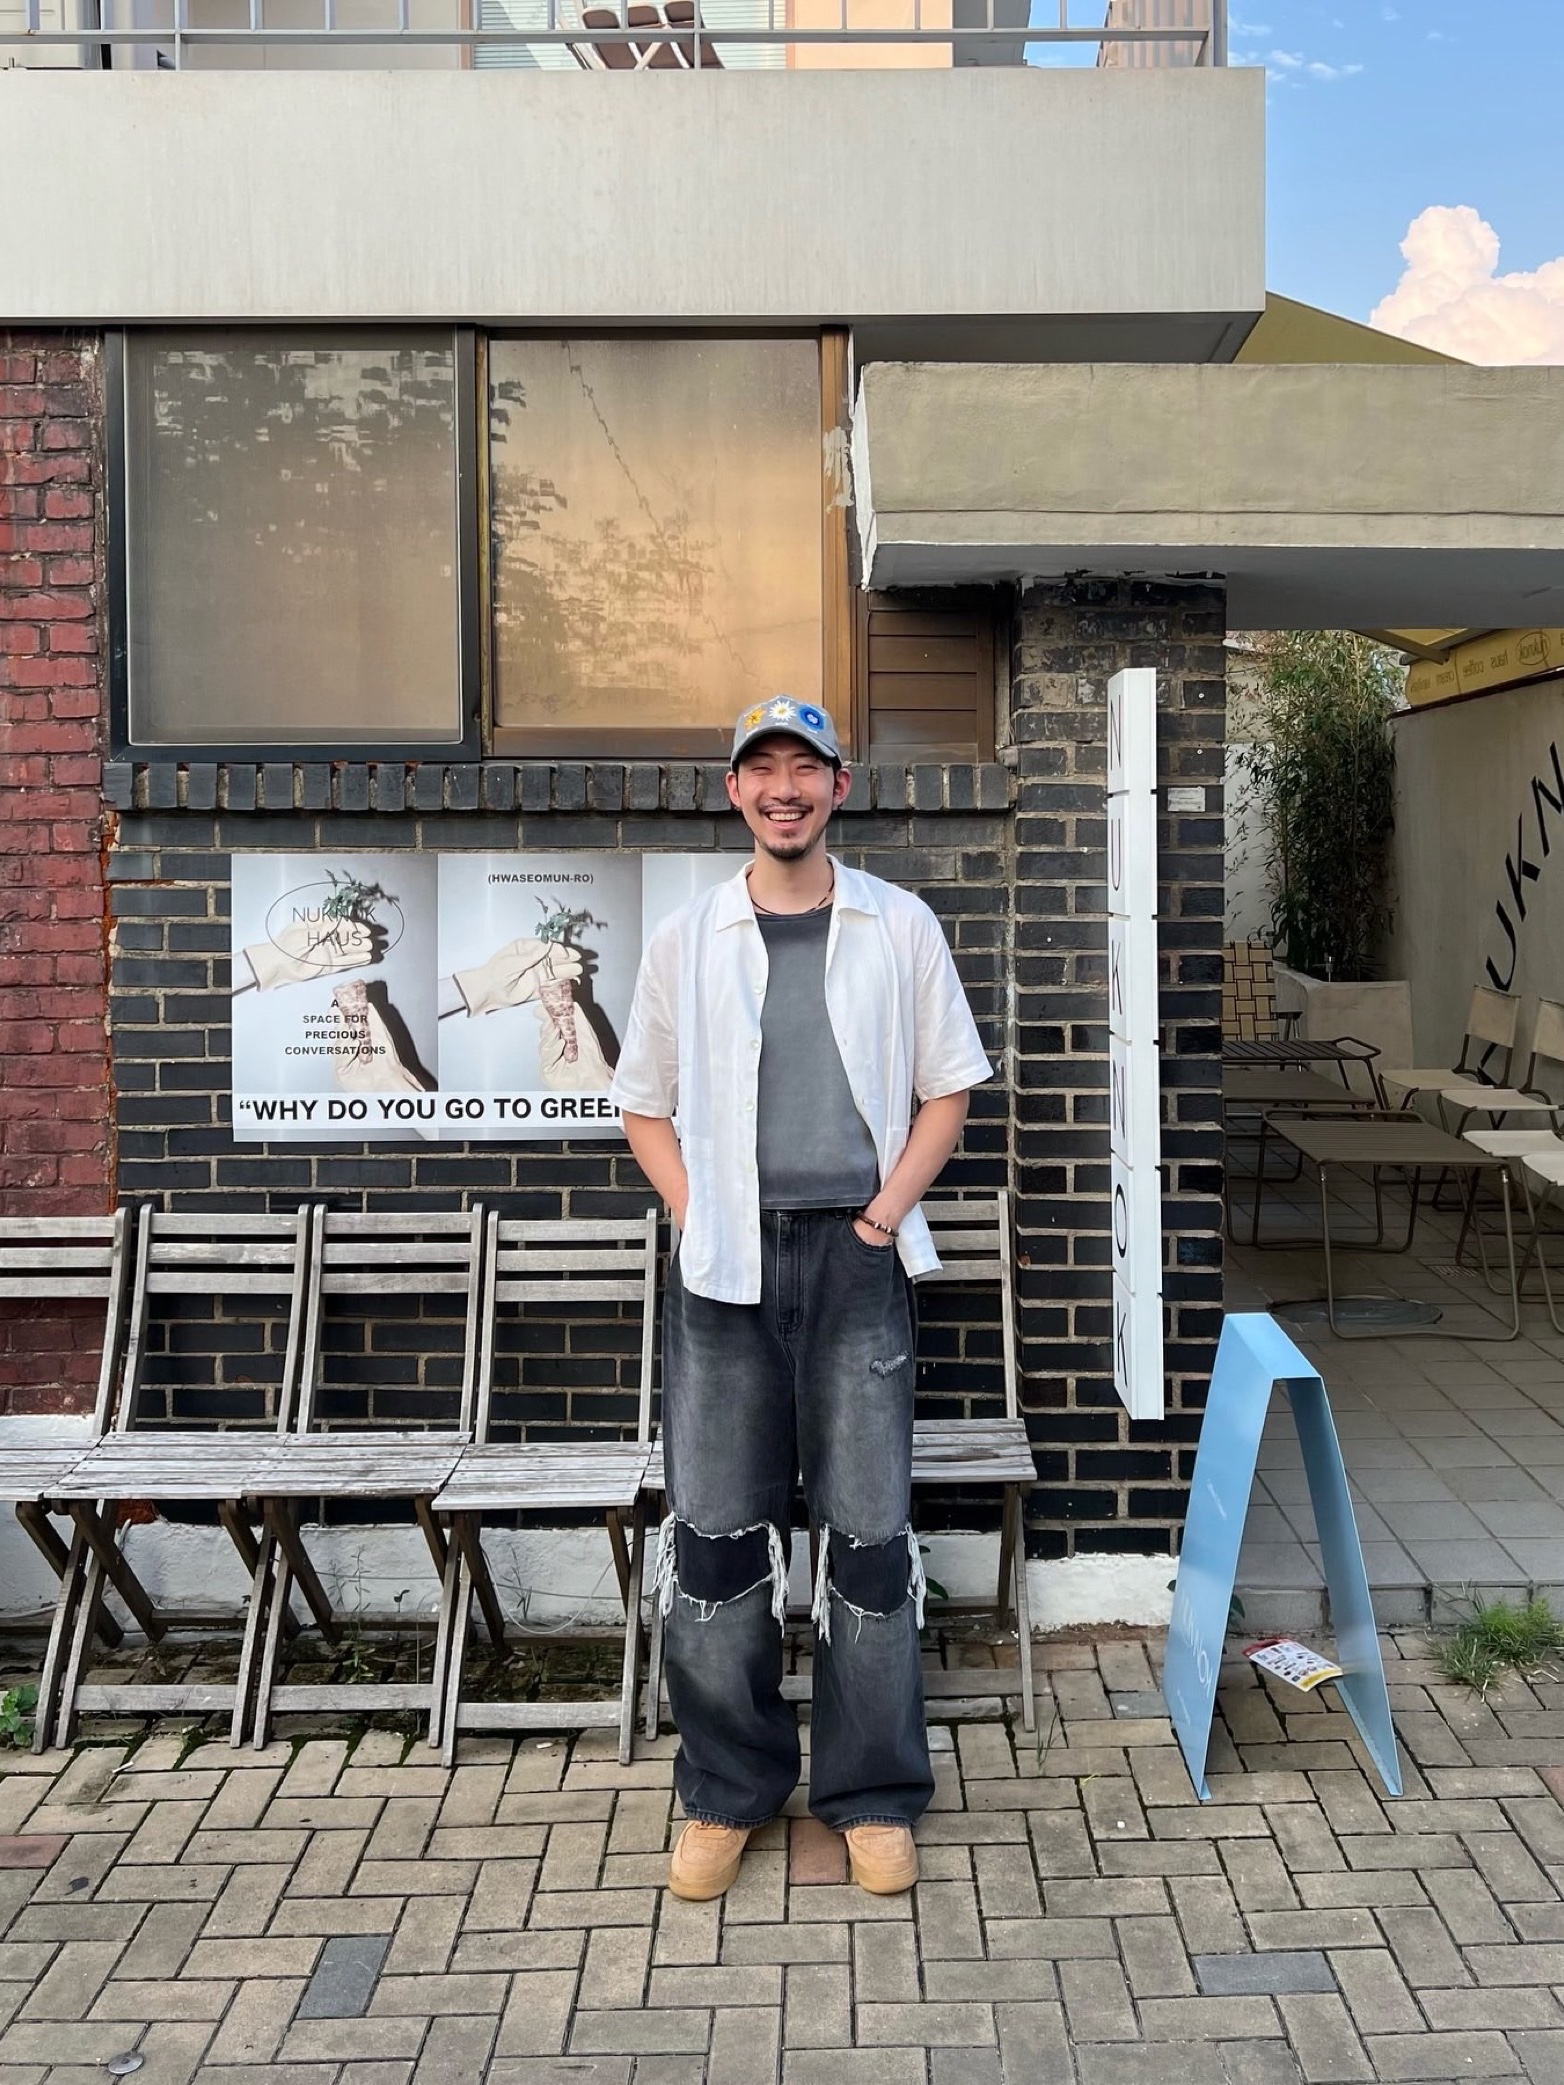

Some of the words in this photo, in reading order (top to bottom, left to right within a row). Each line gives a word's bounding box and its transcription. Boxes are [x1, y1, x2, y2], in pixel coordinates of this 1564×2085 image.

[488, 873, 594, 884] (HWASEOMUN-RO)
[308, 930, 363, 946] HAUS
[331, 999, 339, 1008] A
[303, 1015, 341, 1024] SPACE
[344, 1015, 367, 1024] FOR
[305, 1030, 366, 1039] PRECIOUS
[285, 1046, 386, 1055] CONVERSATIONS
[328, 1098, 367, 1120] DO
[377, 1098, 436, 1119] YOU
[445, 1098, 485, 1119] GO
[493, 1098, 532, 1119] TO
[540, 1097, 620, 1119] GREE
